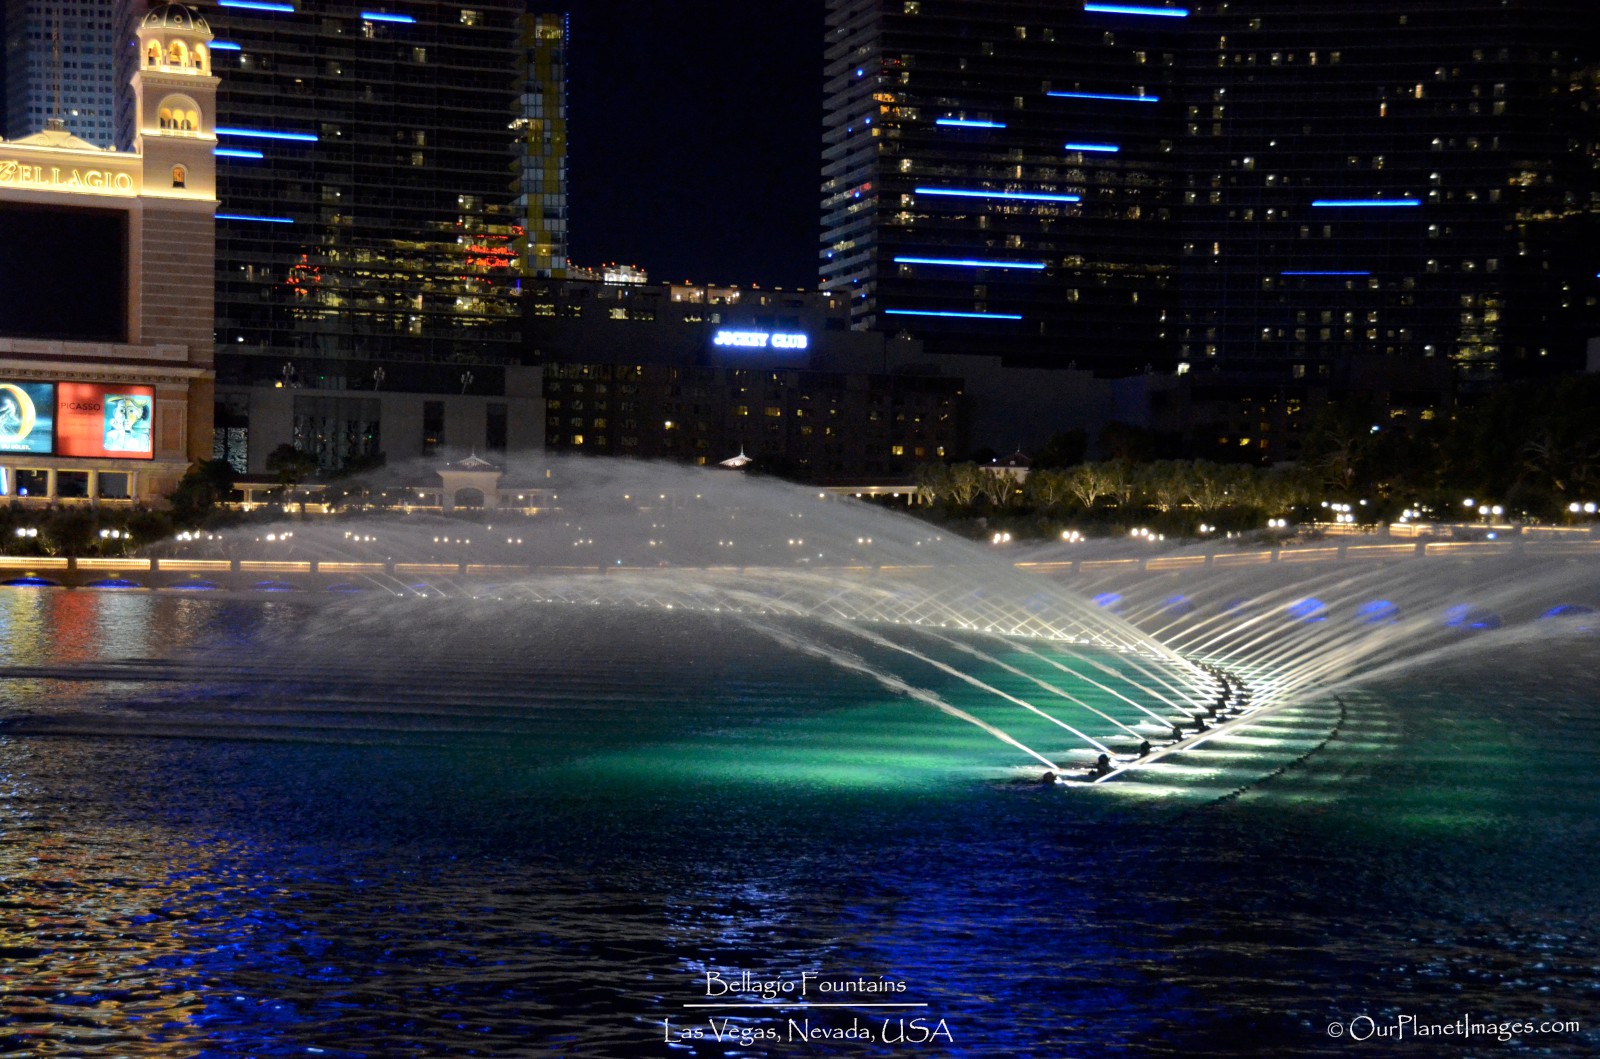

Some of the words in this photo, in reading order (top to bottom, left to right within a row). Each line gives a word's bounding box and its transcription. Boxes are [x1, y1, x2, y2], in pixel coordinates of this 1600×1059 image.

[0, 160, 133, 190] BELLAGIO
[714, 331, 769, 347] JOCKEY
[771, 333, 808, 349] CLUB
[60, 402, 101, 411] PICASSO
